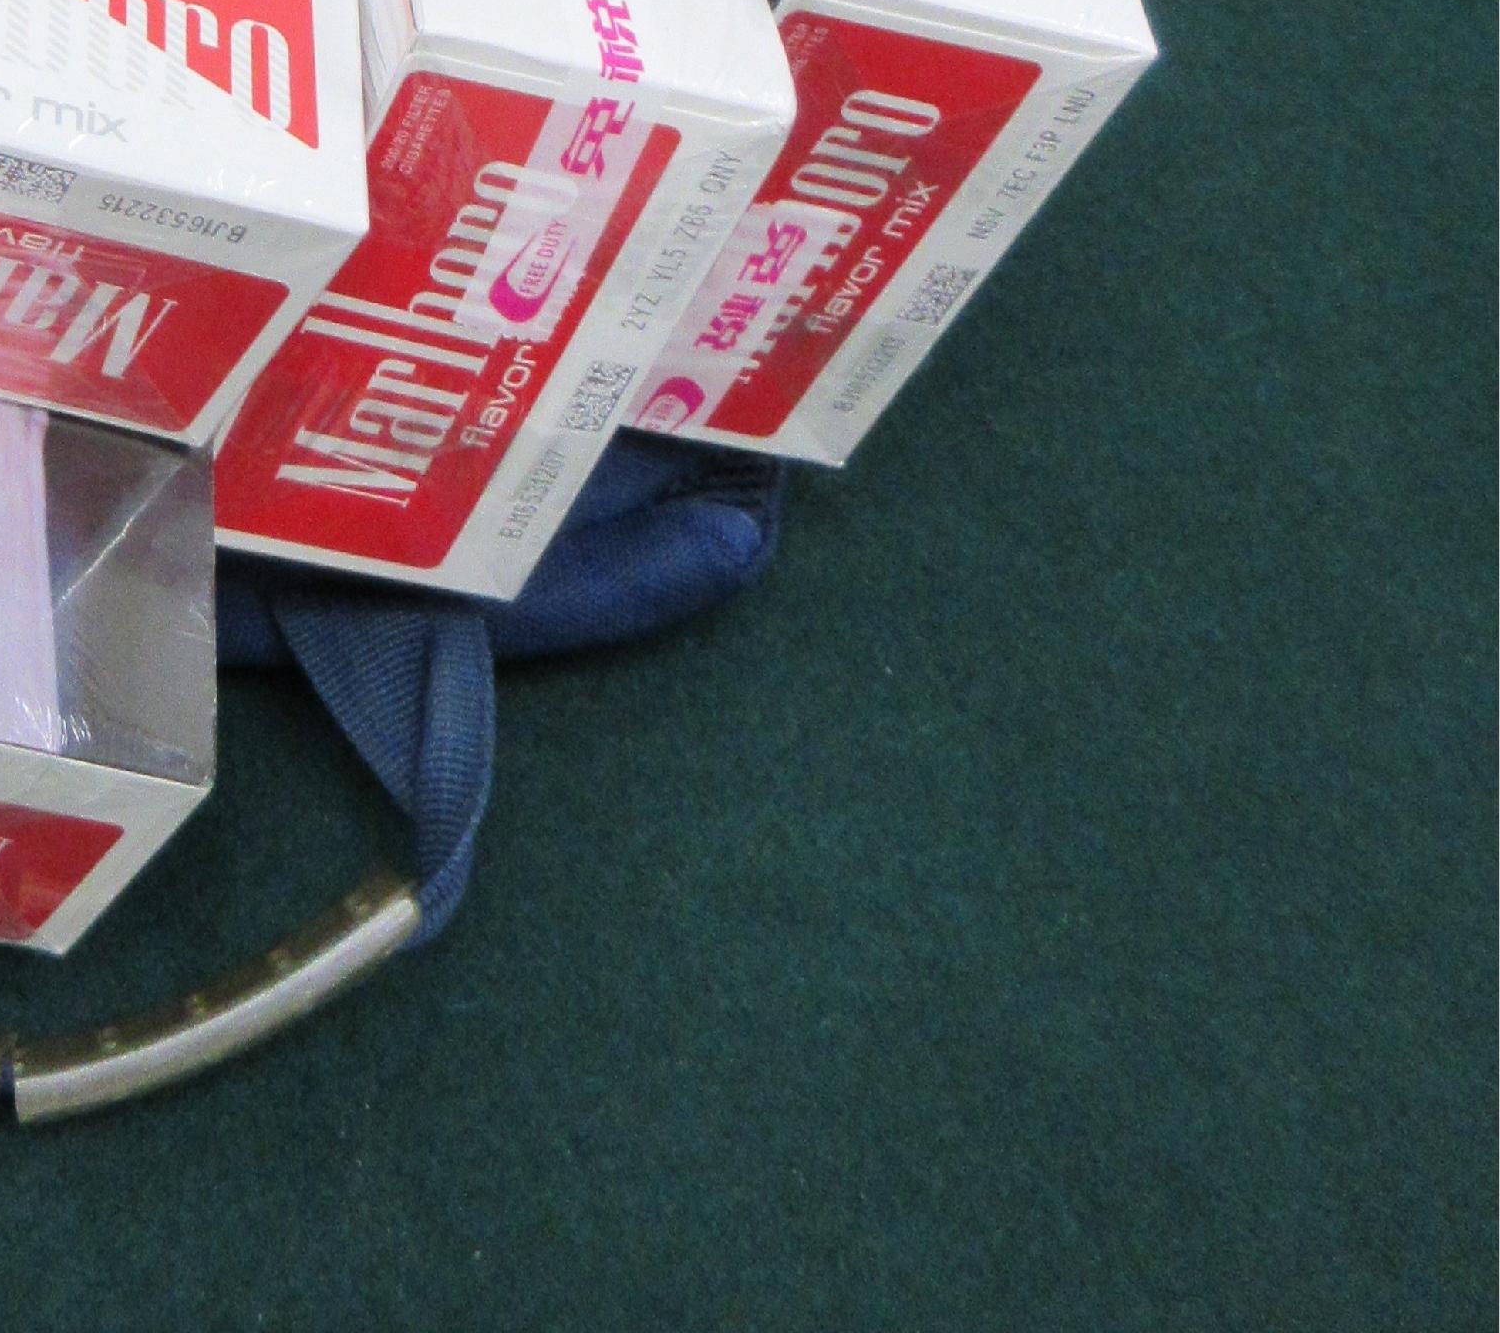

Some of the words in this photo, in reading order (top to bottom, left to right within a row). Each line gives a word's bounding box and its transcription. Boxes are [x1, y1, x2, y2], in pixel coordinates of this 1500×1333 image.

[32, 92, 131, 144] mix
[519, 258, 550, 299] FREE
[536, 219, 569, 262] DUTY
[803, 244, 883, 333] flavor
[884, 179, 940, 239] mix
[460, 341, 538, 449] flavor
